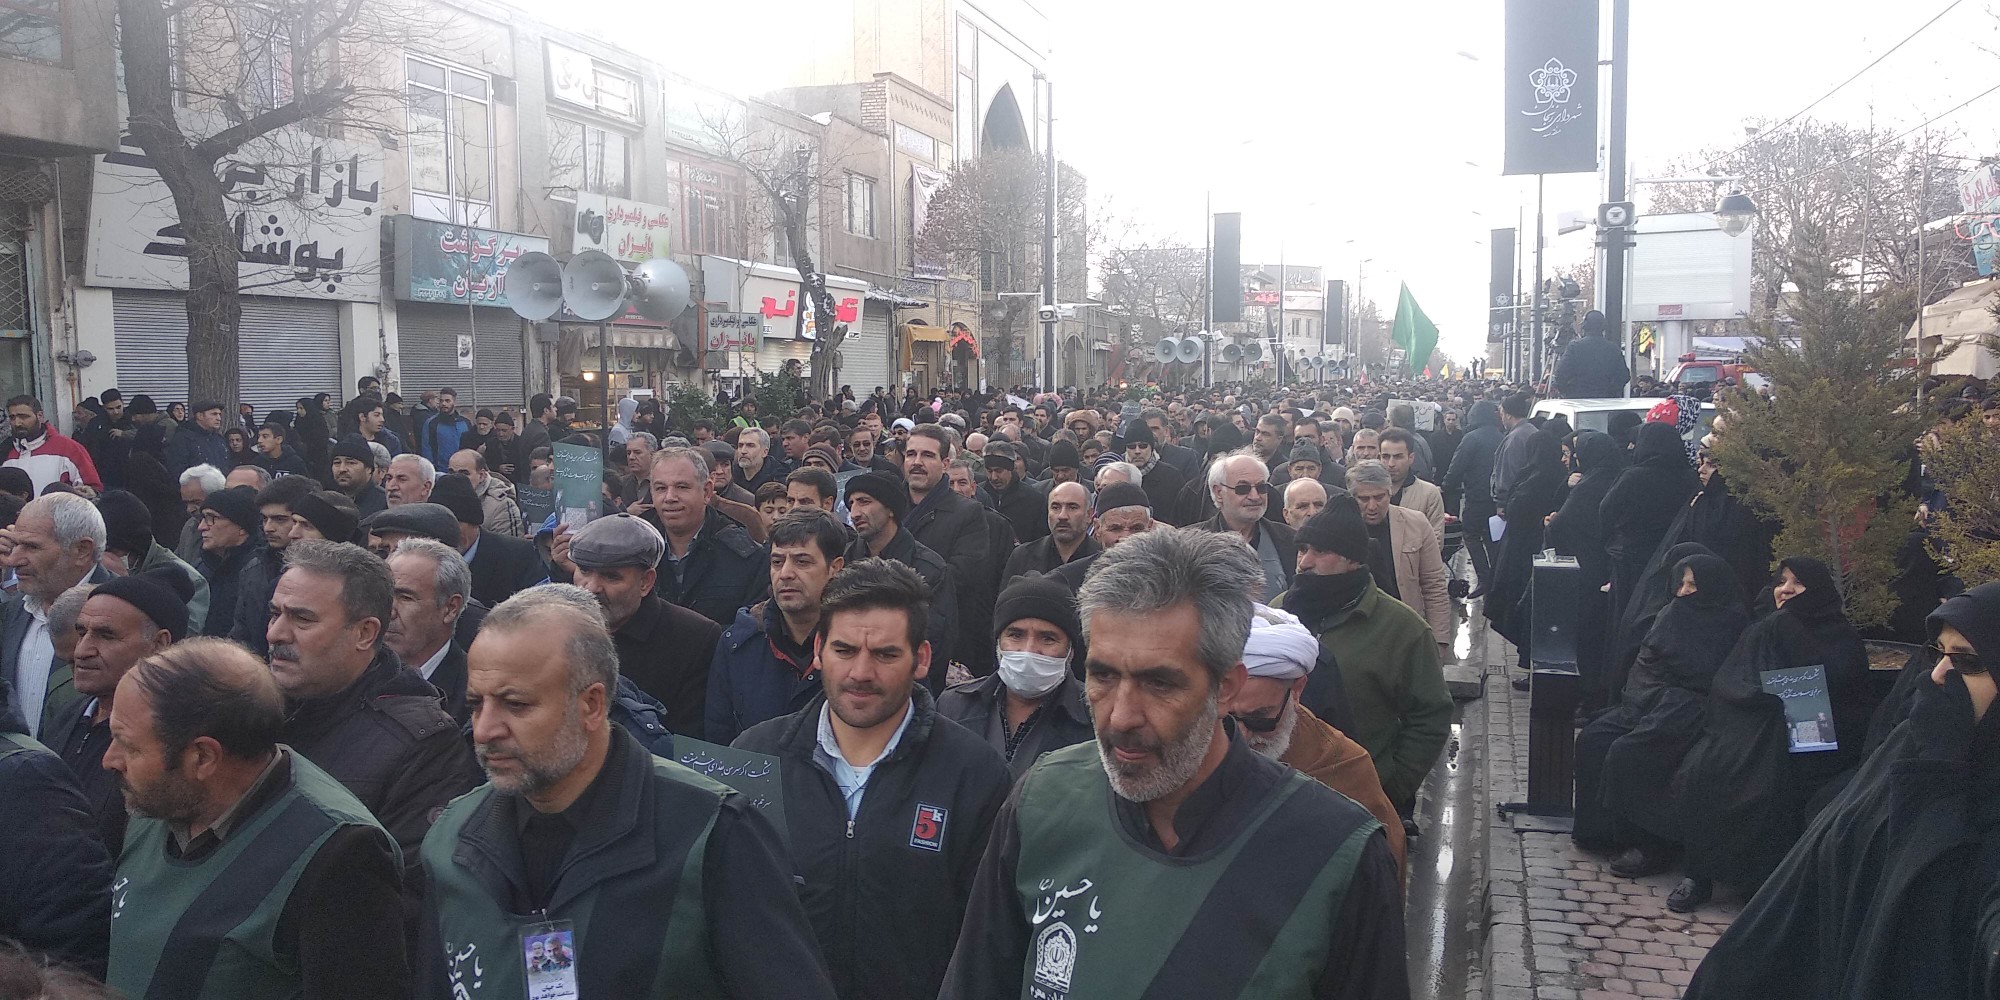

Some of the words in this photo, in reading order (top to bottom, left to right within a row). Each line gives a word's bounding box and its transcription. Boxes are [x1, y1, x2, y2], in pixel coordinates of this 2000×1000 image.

[287, 146, 378, 216] بازار
[607, 205, 642, 227] فیلمبرداری
[641, 215, 648, 229] و
[648, 212, 669, 230] عکاسی
[440, 228, 497, 263] گوشت
[741, 315, 757, 329] عکاسی
[746, 760, 772, 783] بشکست
[1032, 878, 1094, 925] حسین
[1083, 895, 1102, 933] یا
